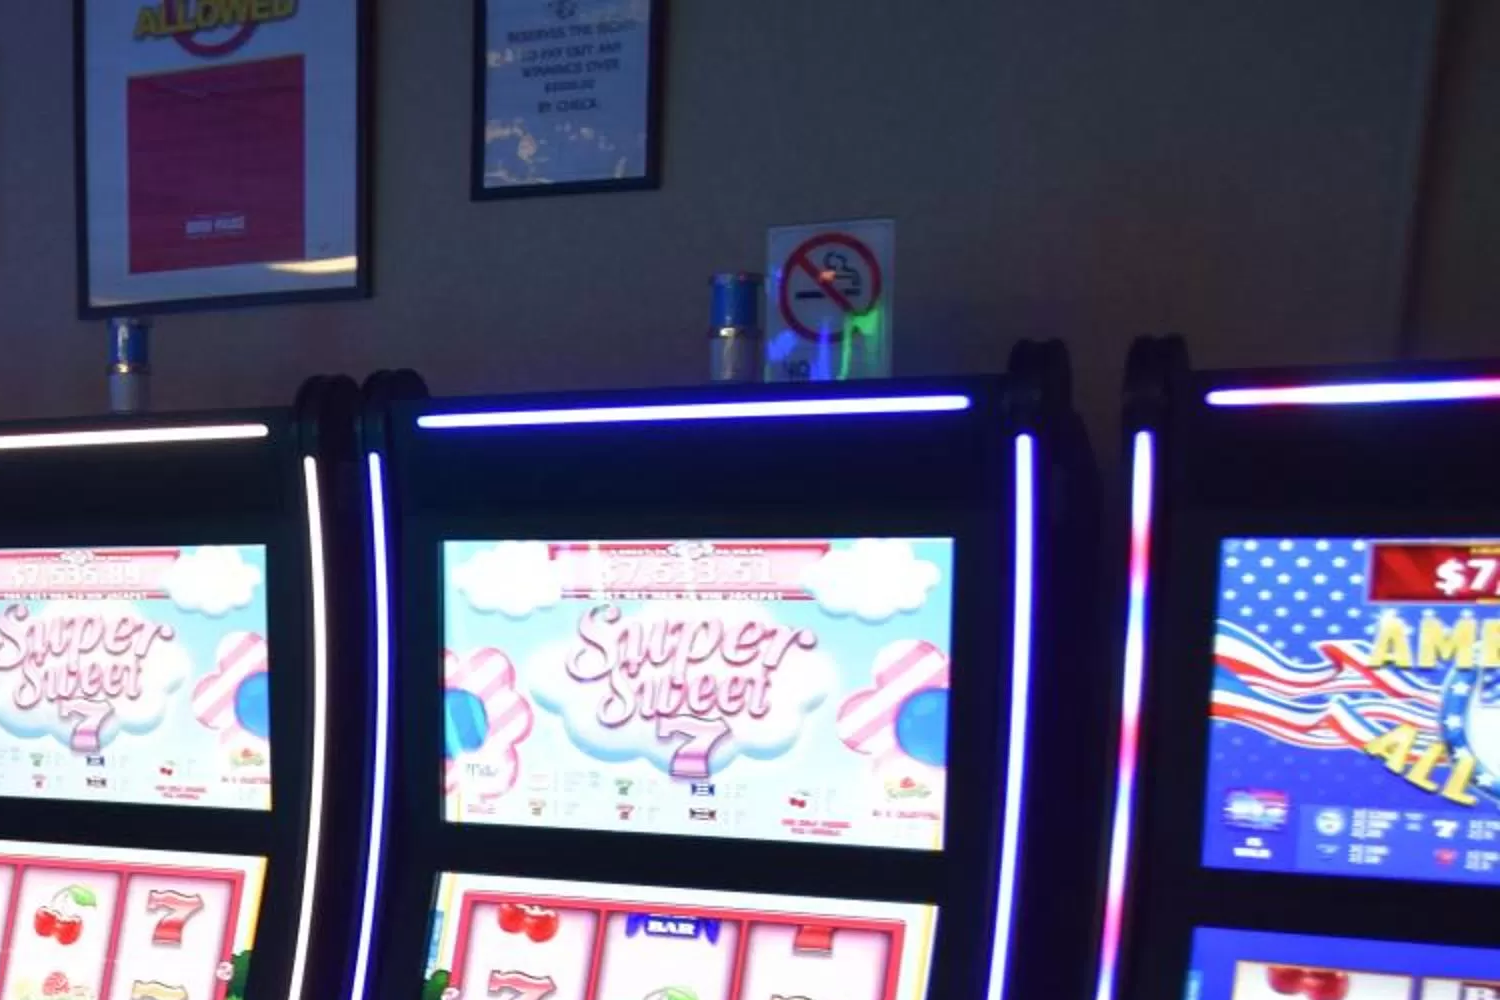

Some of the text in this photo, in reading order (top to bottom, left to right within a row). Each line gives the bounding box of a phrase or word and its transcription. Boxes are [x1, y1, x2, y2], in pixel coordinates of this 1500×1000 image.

[566, 604, 817, 682] Super
[12, 654, 144, 711] Sweet
[597, 662, 772, 728] Sweet
[58, 697, 117, 754] 7
[657, 713, 733, 779] 7
[1361, 722, 1478, 807] ALL
[146, 889, 205, 947] 7
[646, 919, 696, 935] BAR
